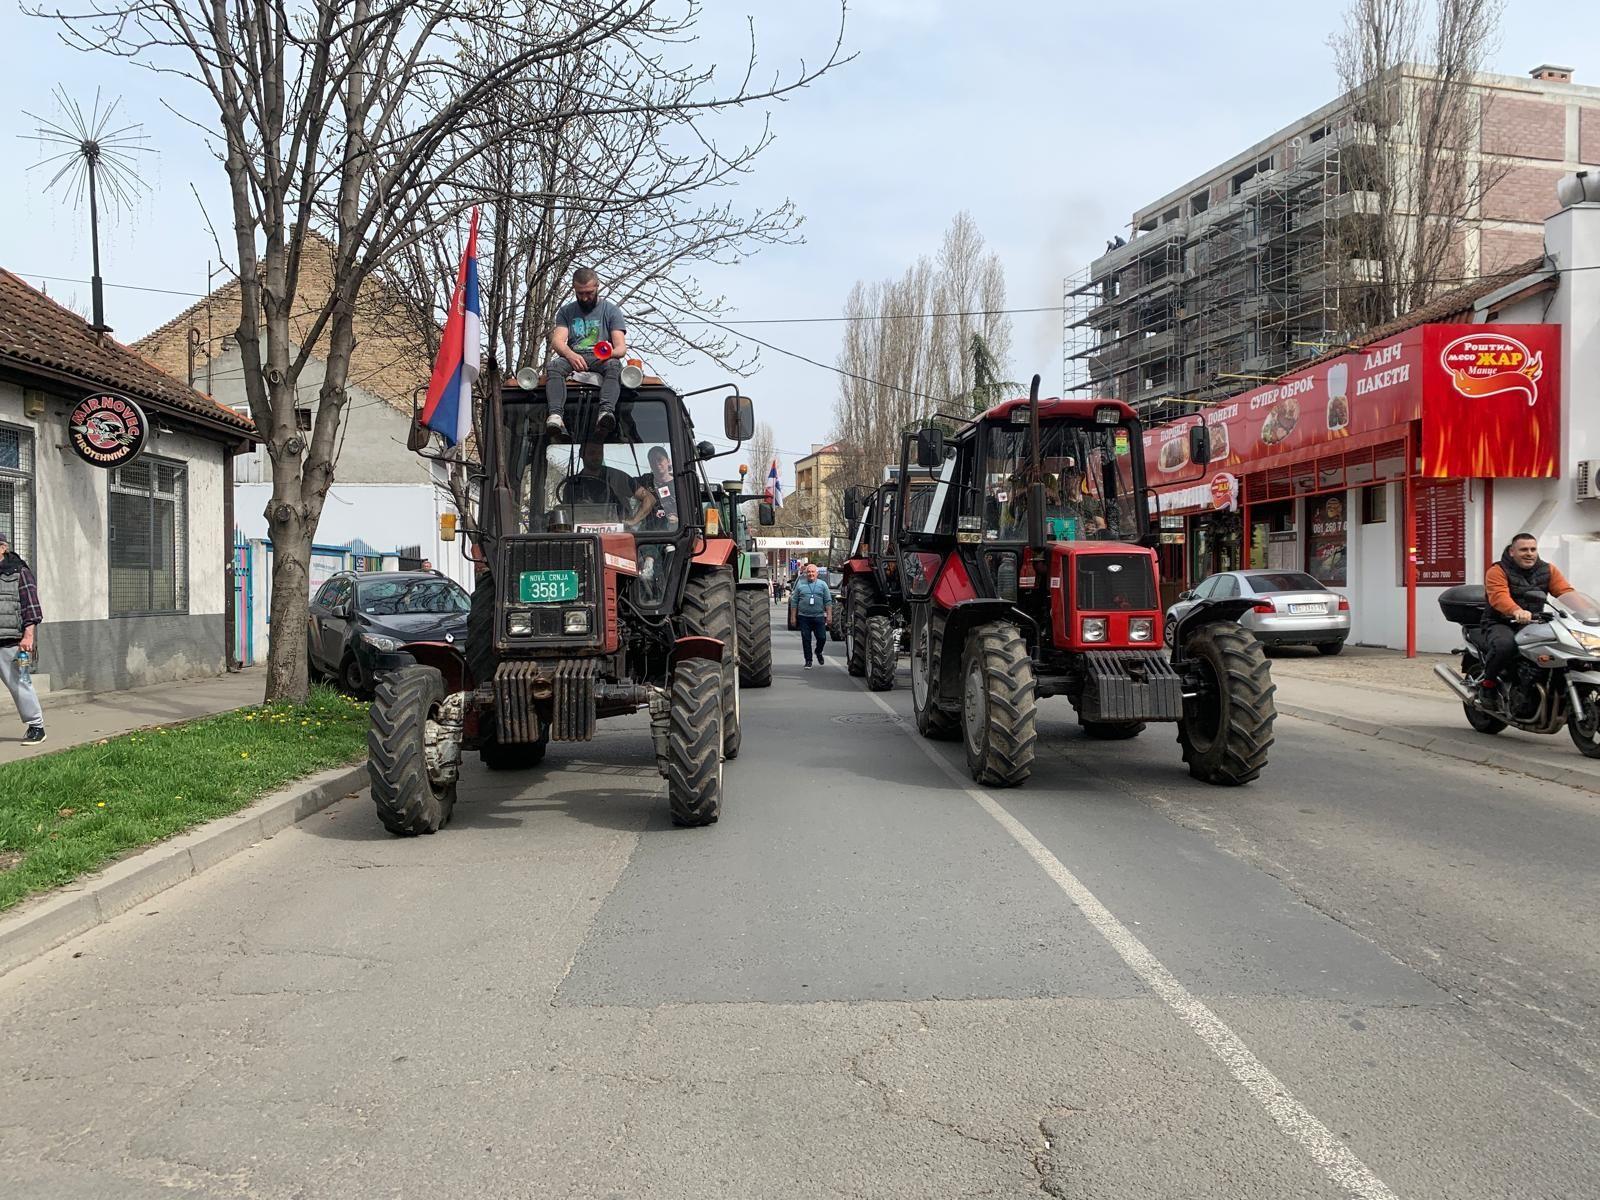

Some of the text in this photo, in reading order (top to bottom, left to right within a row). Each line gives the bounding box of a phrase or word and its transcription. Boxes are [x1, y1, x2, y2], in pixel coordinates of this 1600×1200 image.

[1363, 343, 1403, 371] ЛАНЧ
[1476, 352, 1523, 366] ЖАР
[1250, 375, 1315, 410] СУПЕР ОБРОК
[1356, 364, 1411, 396] ПАКЕТИ
[71, 396, 140, 436] MIRNOVEC
[74, 433, 131, 462] PIROTEHNIKA
[529, 573, 569, 582] NOVA CRNJA
[531, 581, 566, 599] 3581
